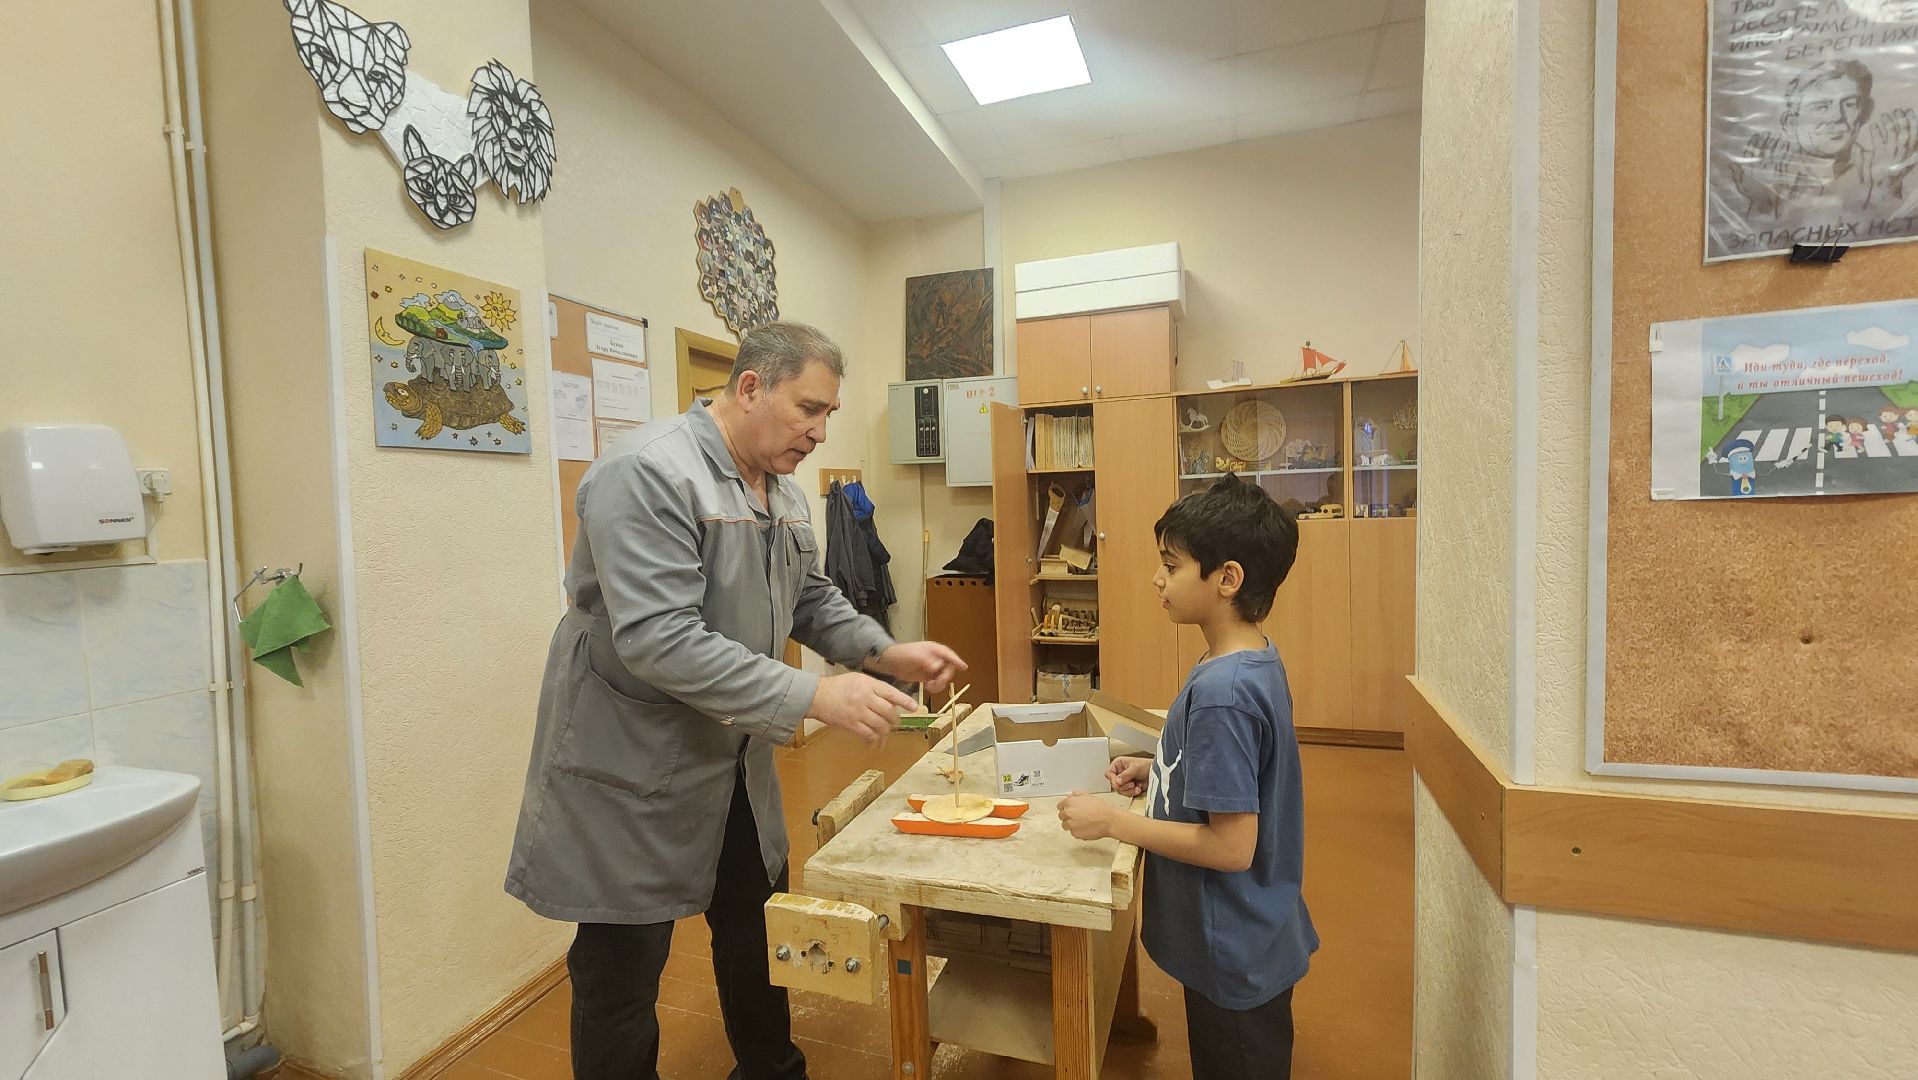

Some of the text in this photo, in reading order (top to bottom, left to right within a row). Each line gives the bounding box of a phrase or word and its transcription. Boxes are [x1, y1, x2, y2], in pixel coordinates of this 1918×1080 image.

[1744, 362, 1767, 374] Иди
[1812, 358, 1832, 369] где
[1737, 369, 1904, 390] и ты отличный пешеход!
